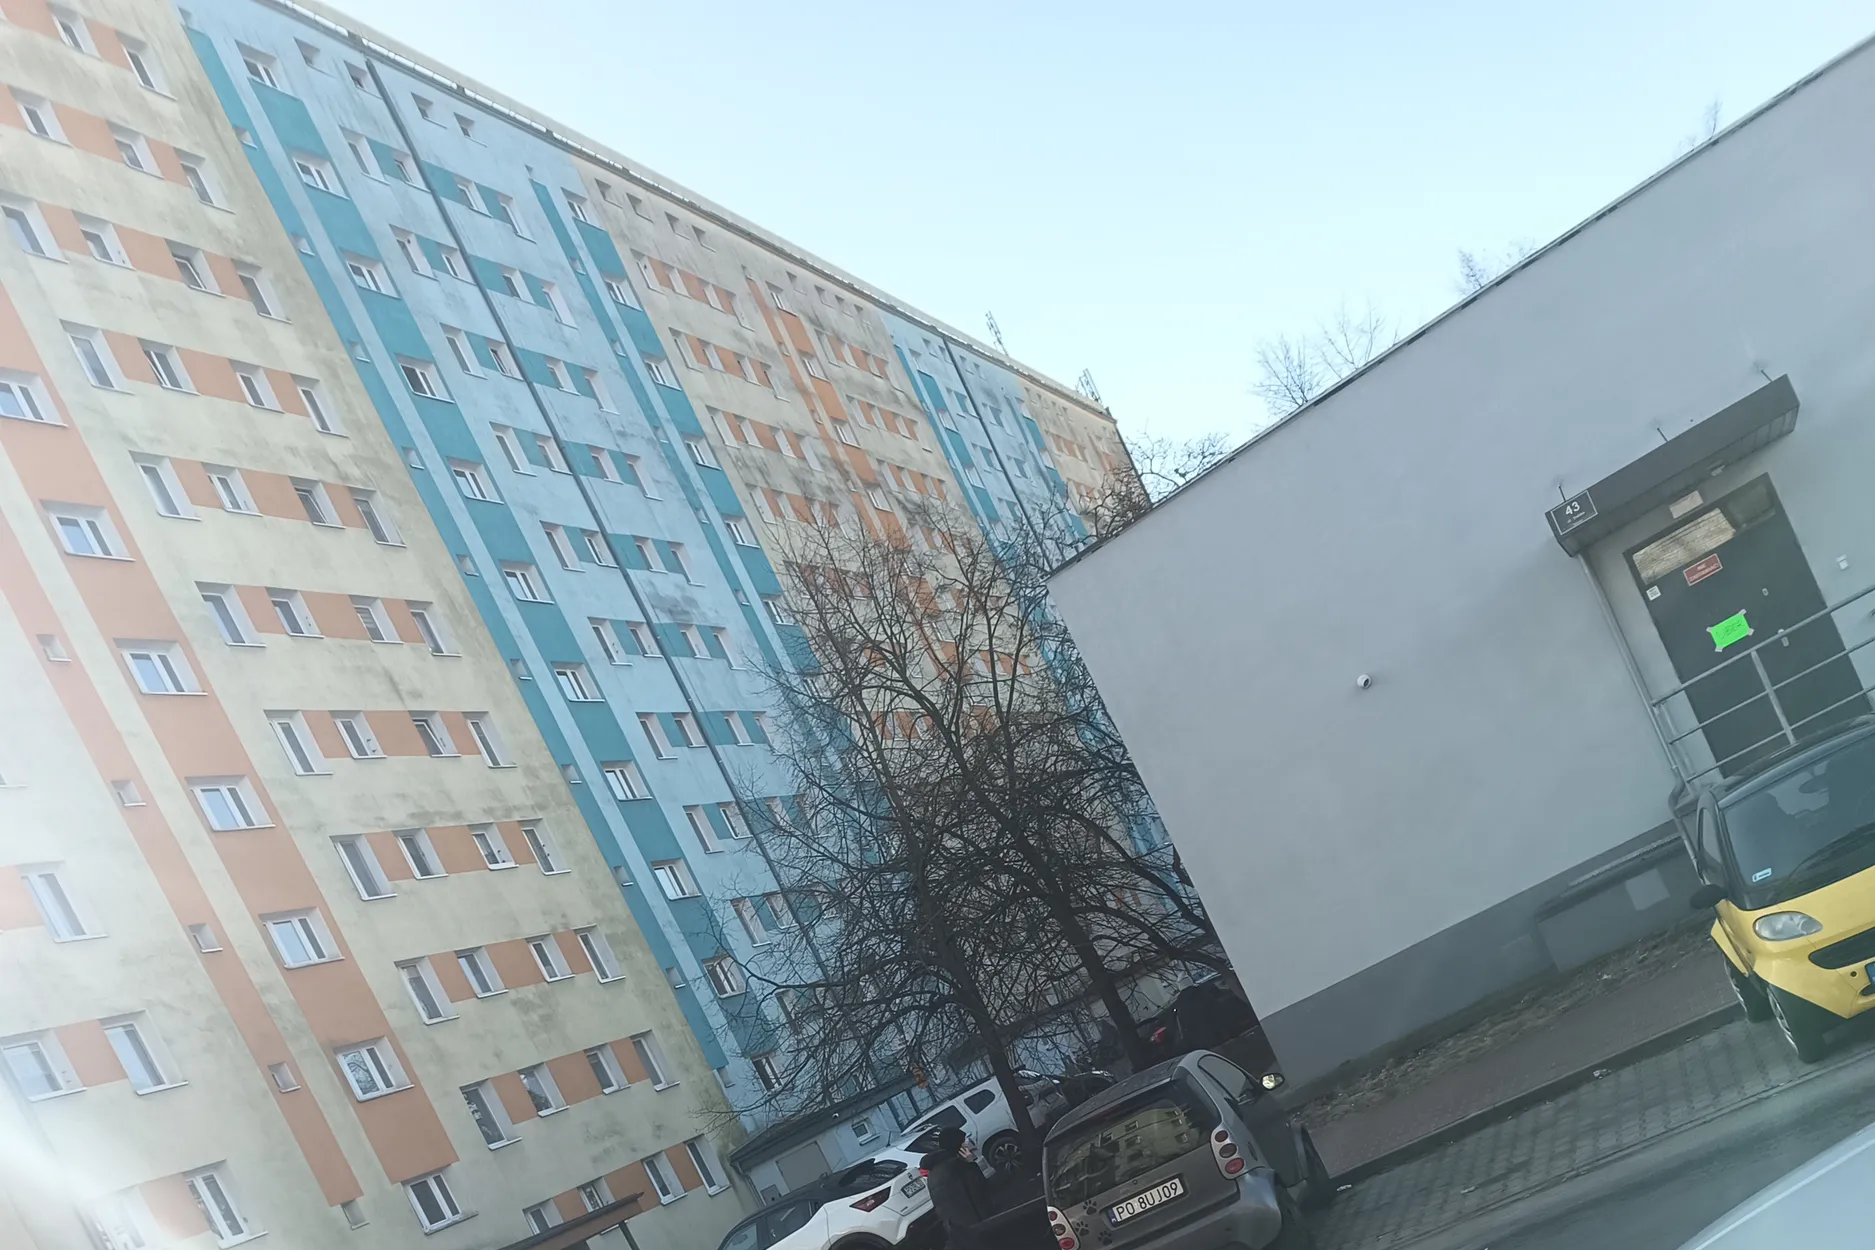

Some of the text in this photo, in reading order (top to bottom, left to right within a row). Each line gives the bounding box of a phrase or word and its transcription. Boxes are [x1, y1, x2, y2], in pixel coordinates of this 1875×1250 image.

[1565, 501, 1580, 515] 43
[1116, 1182, 1178, 1220] PO 8UJ09
